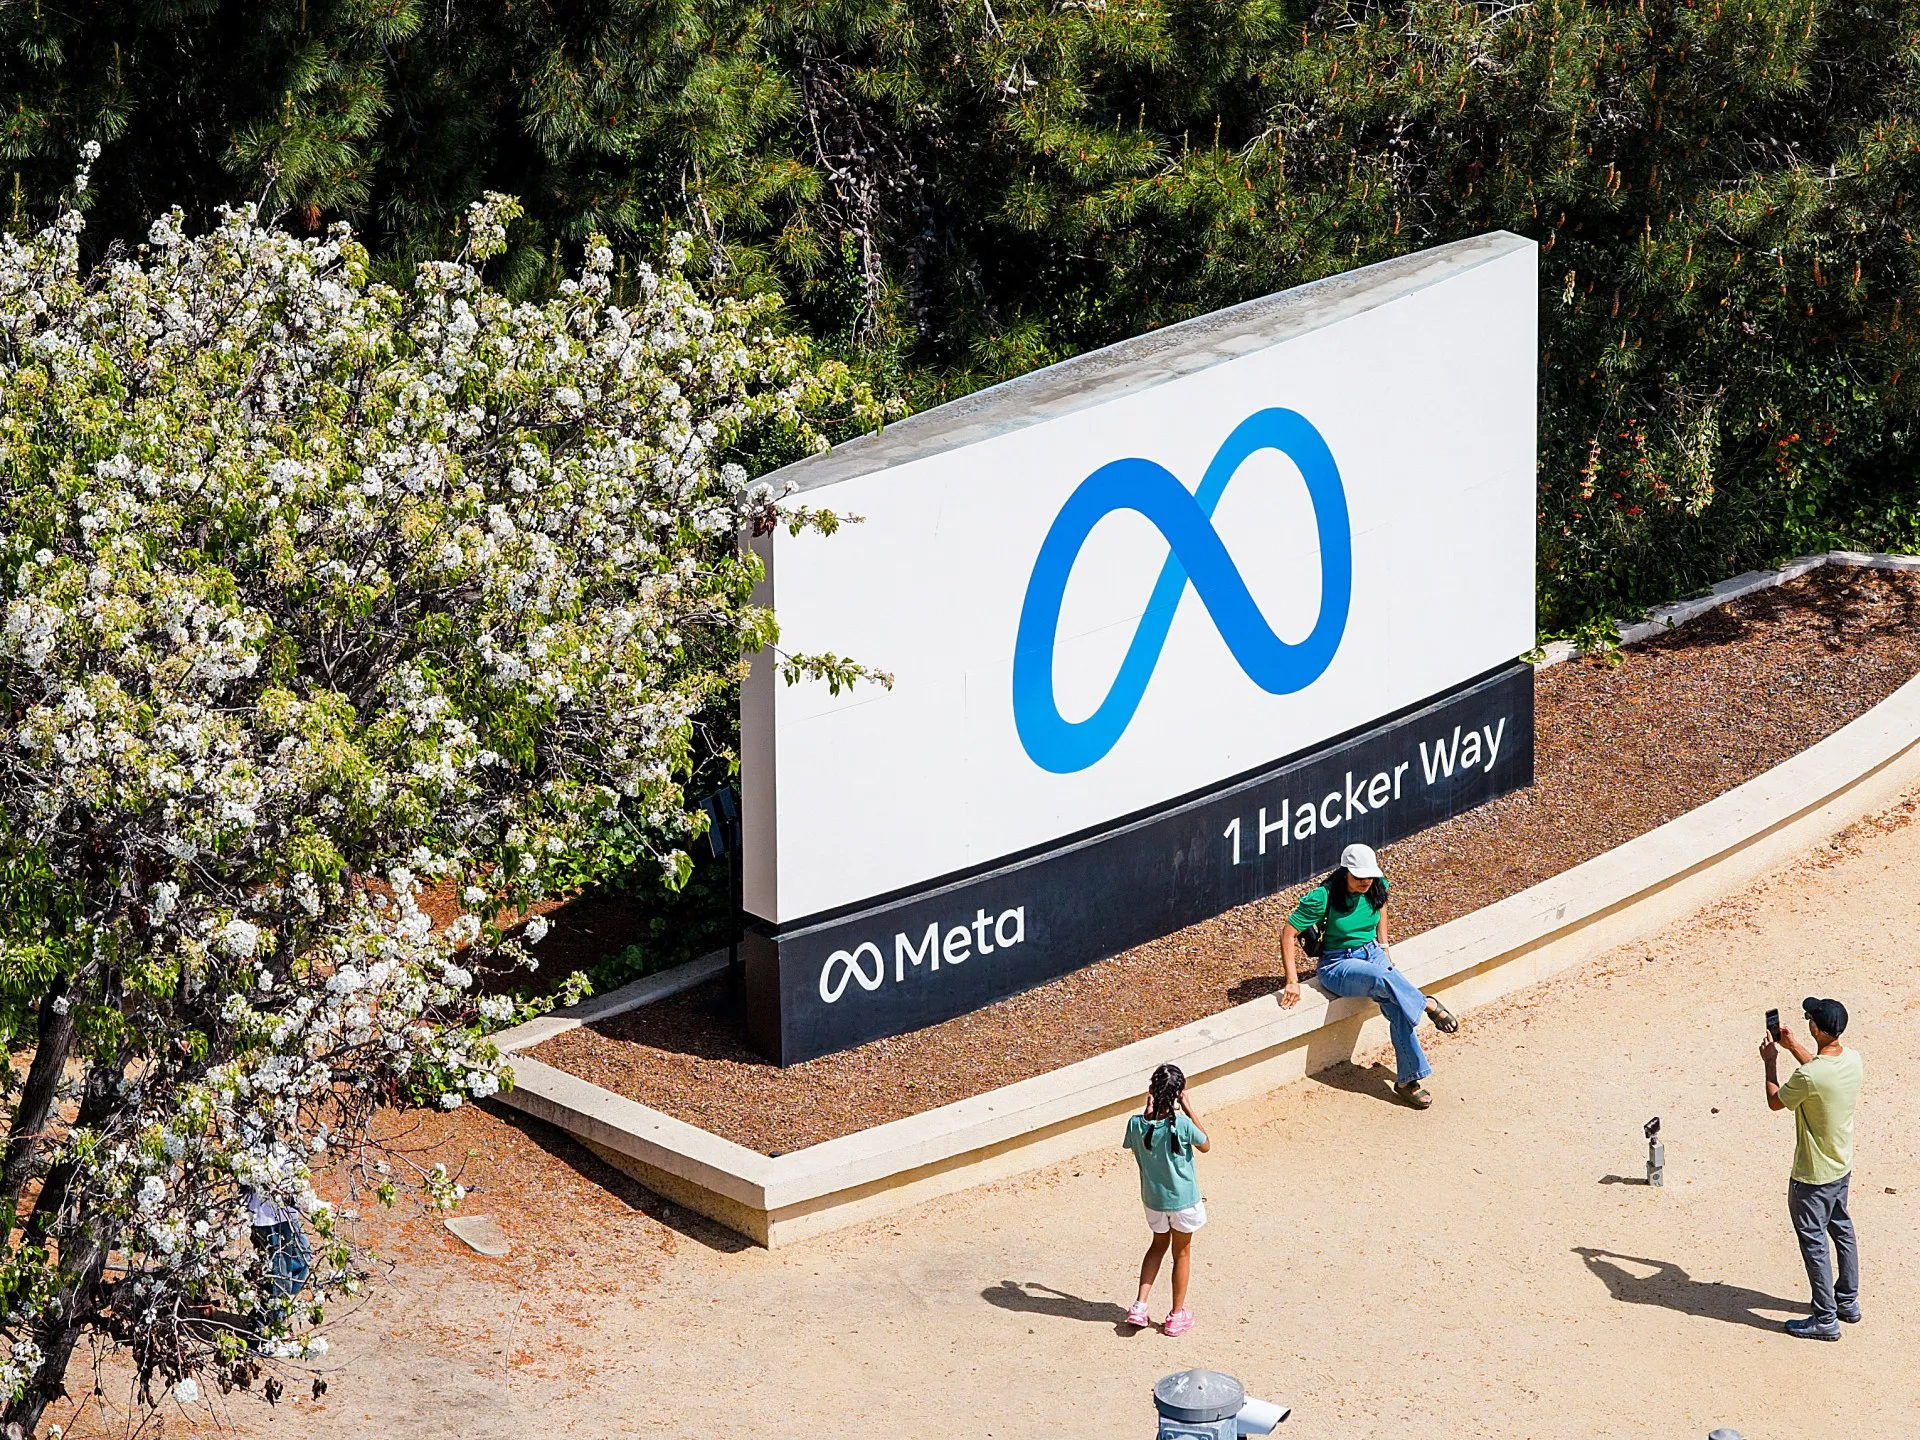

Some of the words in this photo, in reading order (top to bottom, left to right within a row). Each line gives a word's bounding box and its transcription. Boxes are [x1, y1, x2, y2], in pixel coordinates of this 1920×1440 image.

[1223, 817, 1241, 866] 1
[1259, 761, 1409, 855] Hacker
[1418, 717, 1506, 786] Way
[895, 905, 1025, 983] Meta
